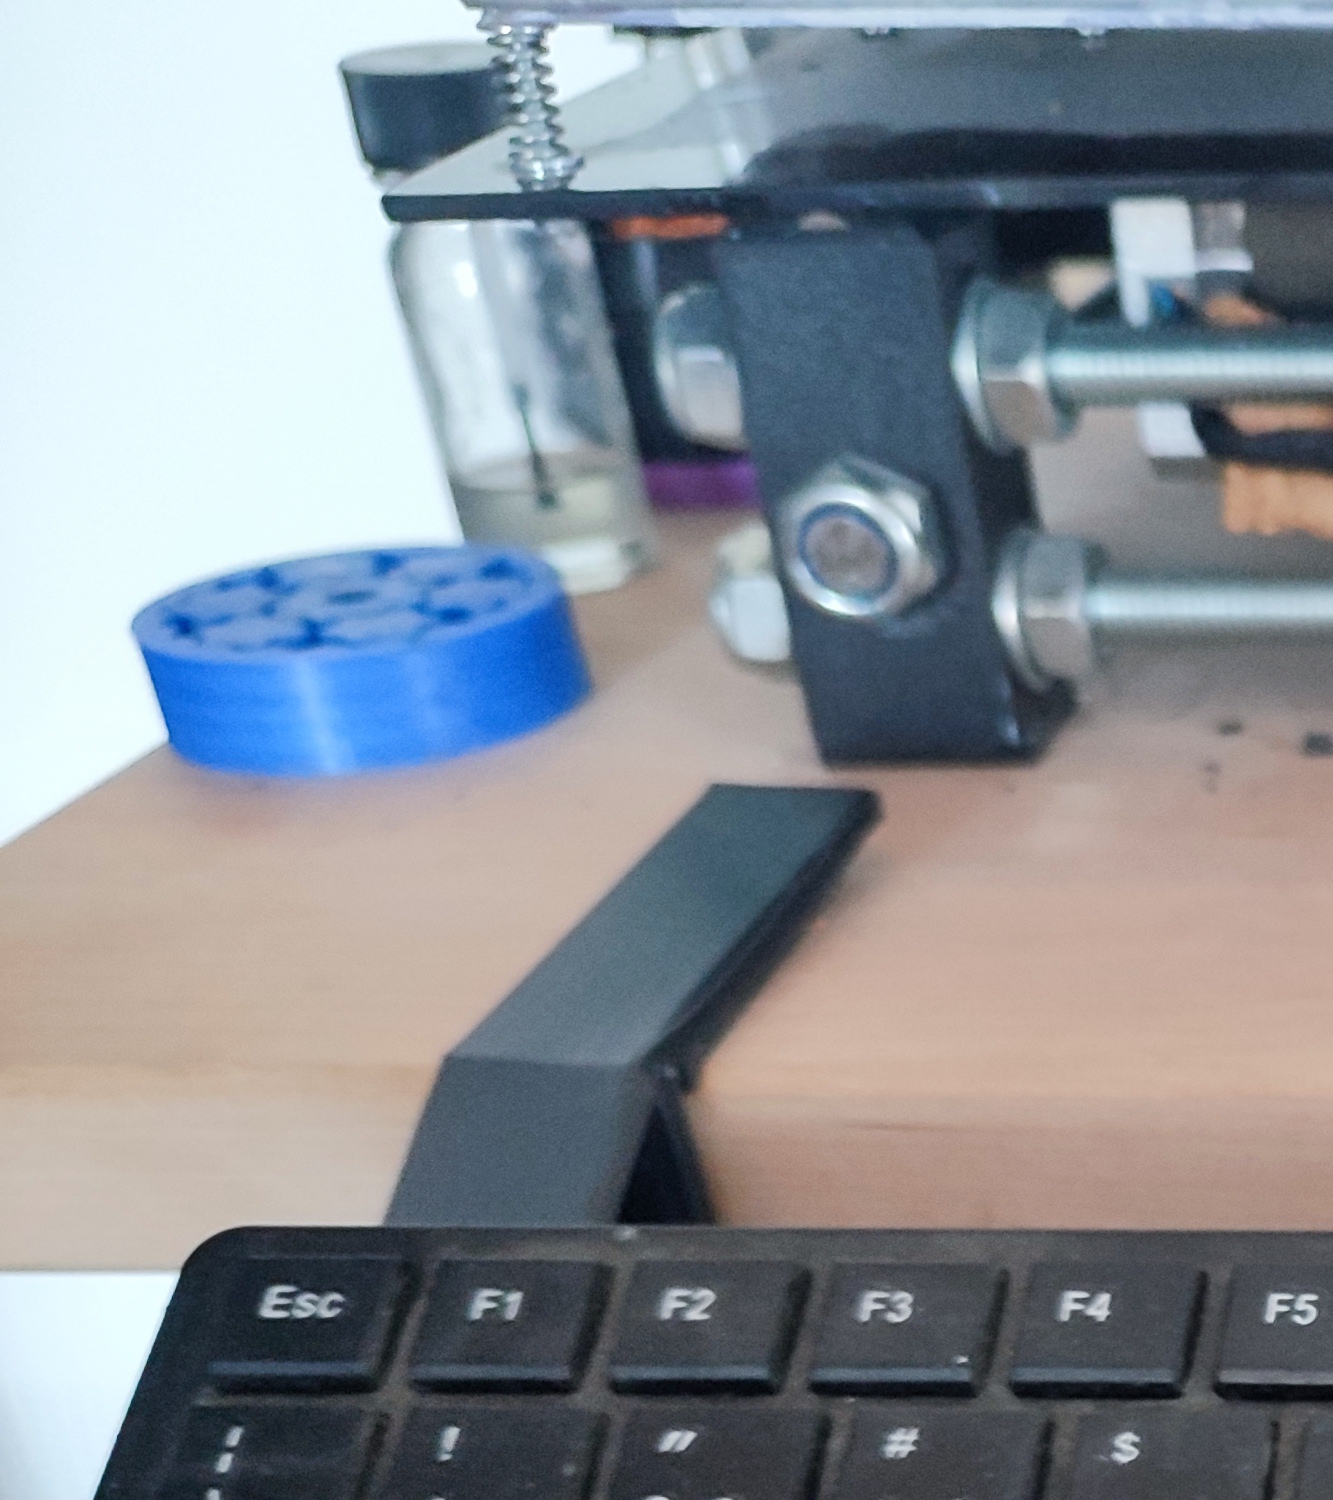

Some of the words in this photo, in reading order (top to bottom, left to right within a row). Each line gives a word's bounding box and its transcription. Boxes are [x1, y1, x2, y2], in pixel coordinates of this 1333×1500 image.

[257, 1283, 347, 1320] Esc
[467, 1287, 525, 1322] F1
[657, 1286, 718, 1322] F2
[855, 1289, 915, 1324] F3
[1057, 1289, 1113, 1323] F4
[1263, 1291, 1320, 1327] F5
[881, 1426, 920, 1459] #
[1109, 1430, 1142, 1465] $
